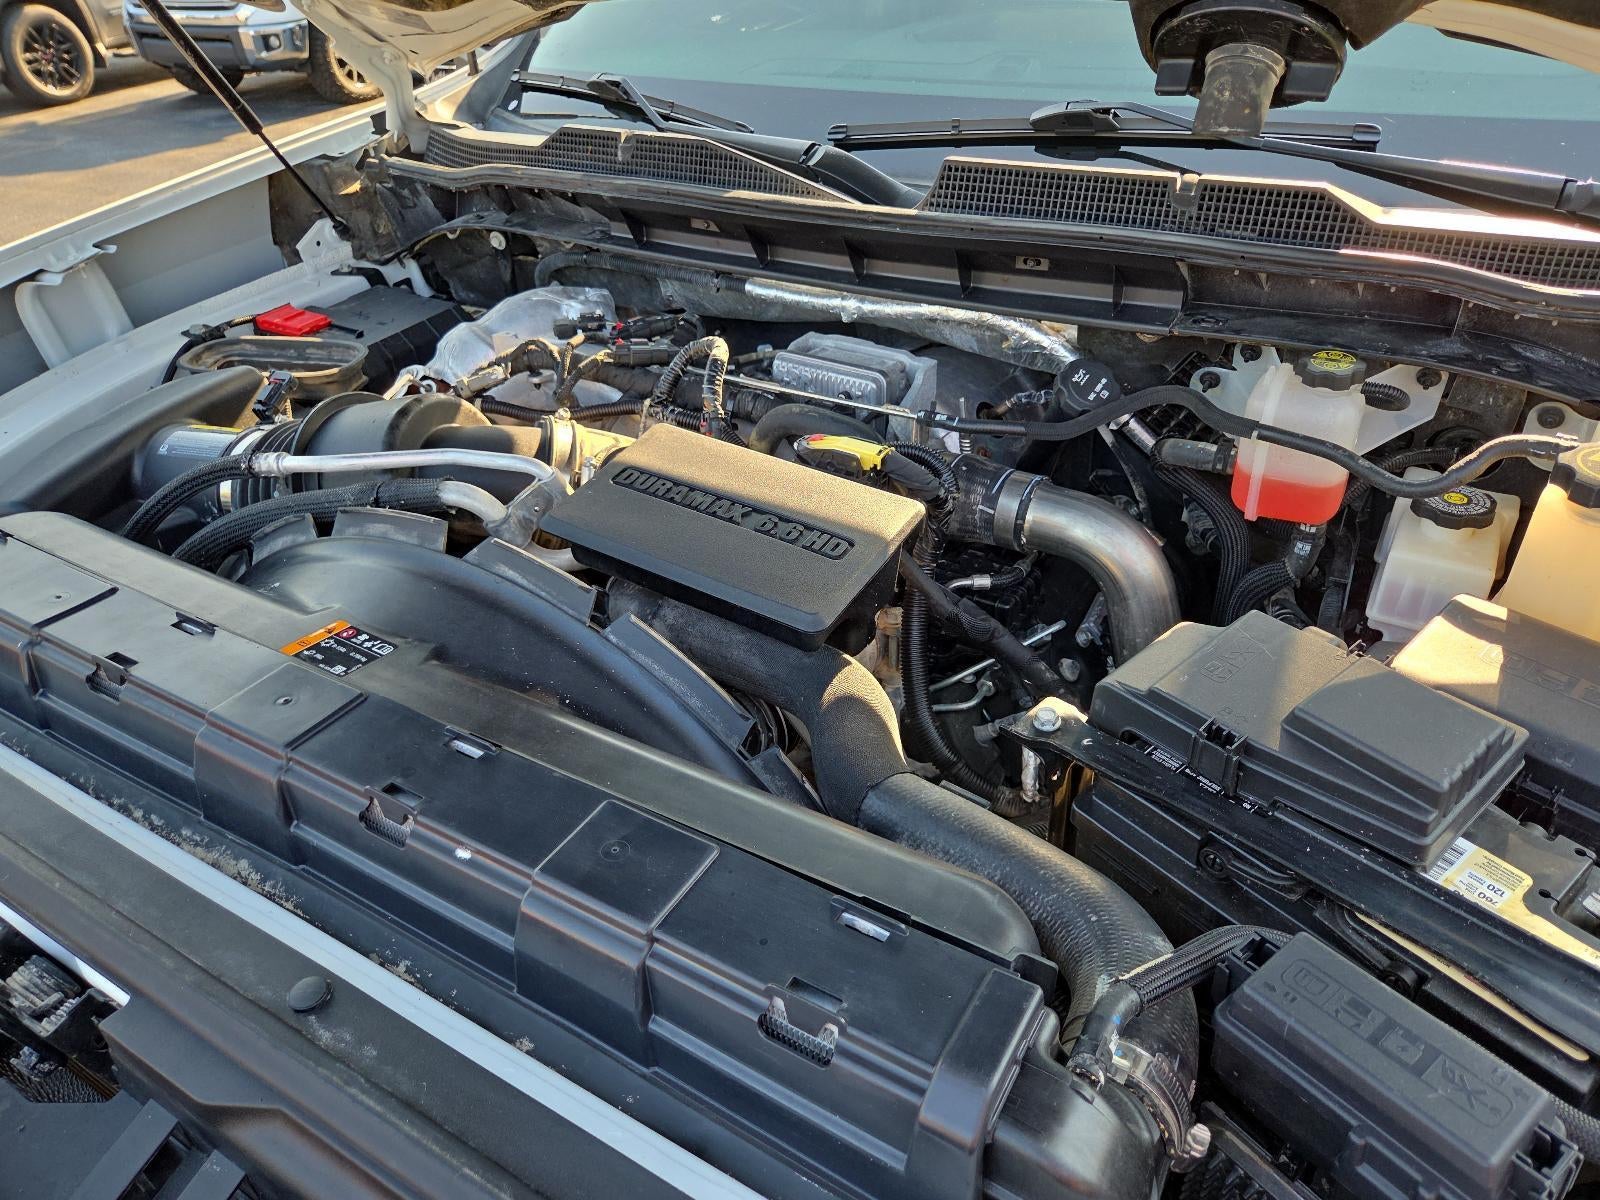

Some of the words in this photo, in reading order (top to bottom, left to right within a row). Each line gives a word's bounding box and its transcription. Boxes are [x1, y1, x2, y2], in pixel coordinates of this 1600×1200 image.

[616, 466, 753, 522] DURAMAX
[755, 513, 805, 541] 6.6
[801, 529, 850, 557] HD
[1487, 883, 1505, 897] 120
[1477, 891, 1498, 905] 760
